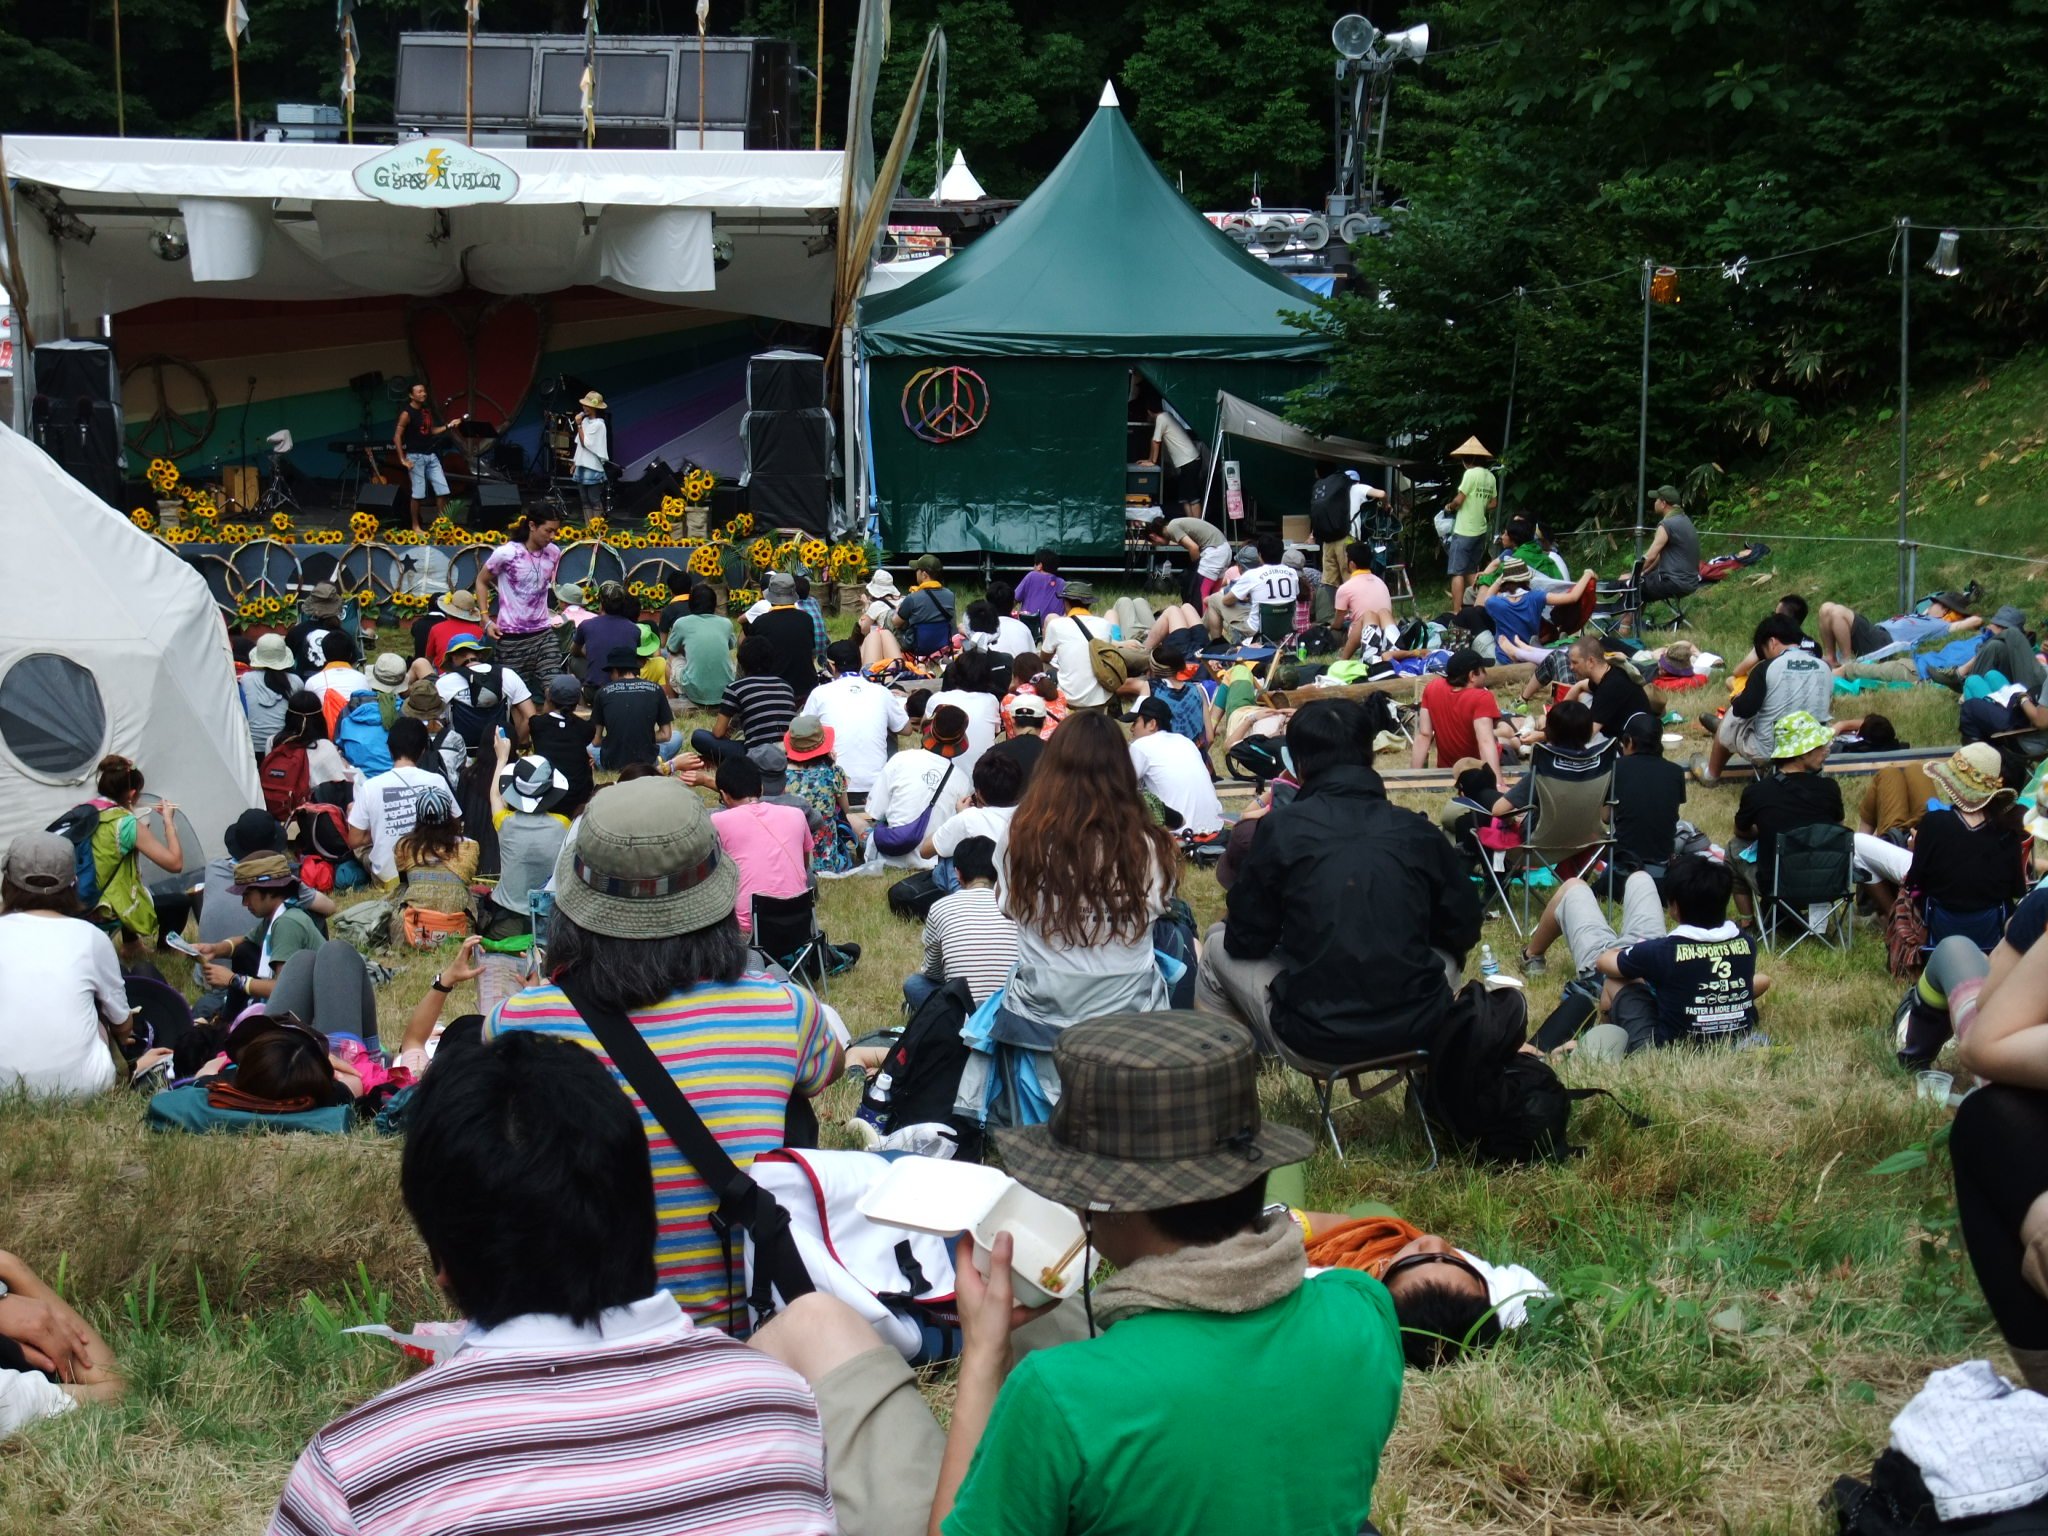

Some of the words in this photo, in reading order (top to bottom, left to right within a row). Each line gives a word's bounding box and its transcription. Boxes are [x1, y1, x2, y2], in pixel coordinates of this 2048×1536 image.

[1265, 577, 1292, 600] 10
[1730, 938, 1751, 955] WEAR
[1709, 956, 1732, 979] 73
[1685, 1006, 1709, 1015] FASTER
[1714, 1004, 1730, 1013] MORE
